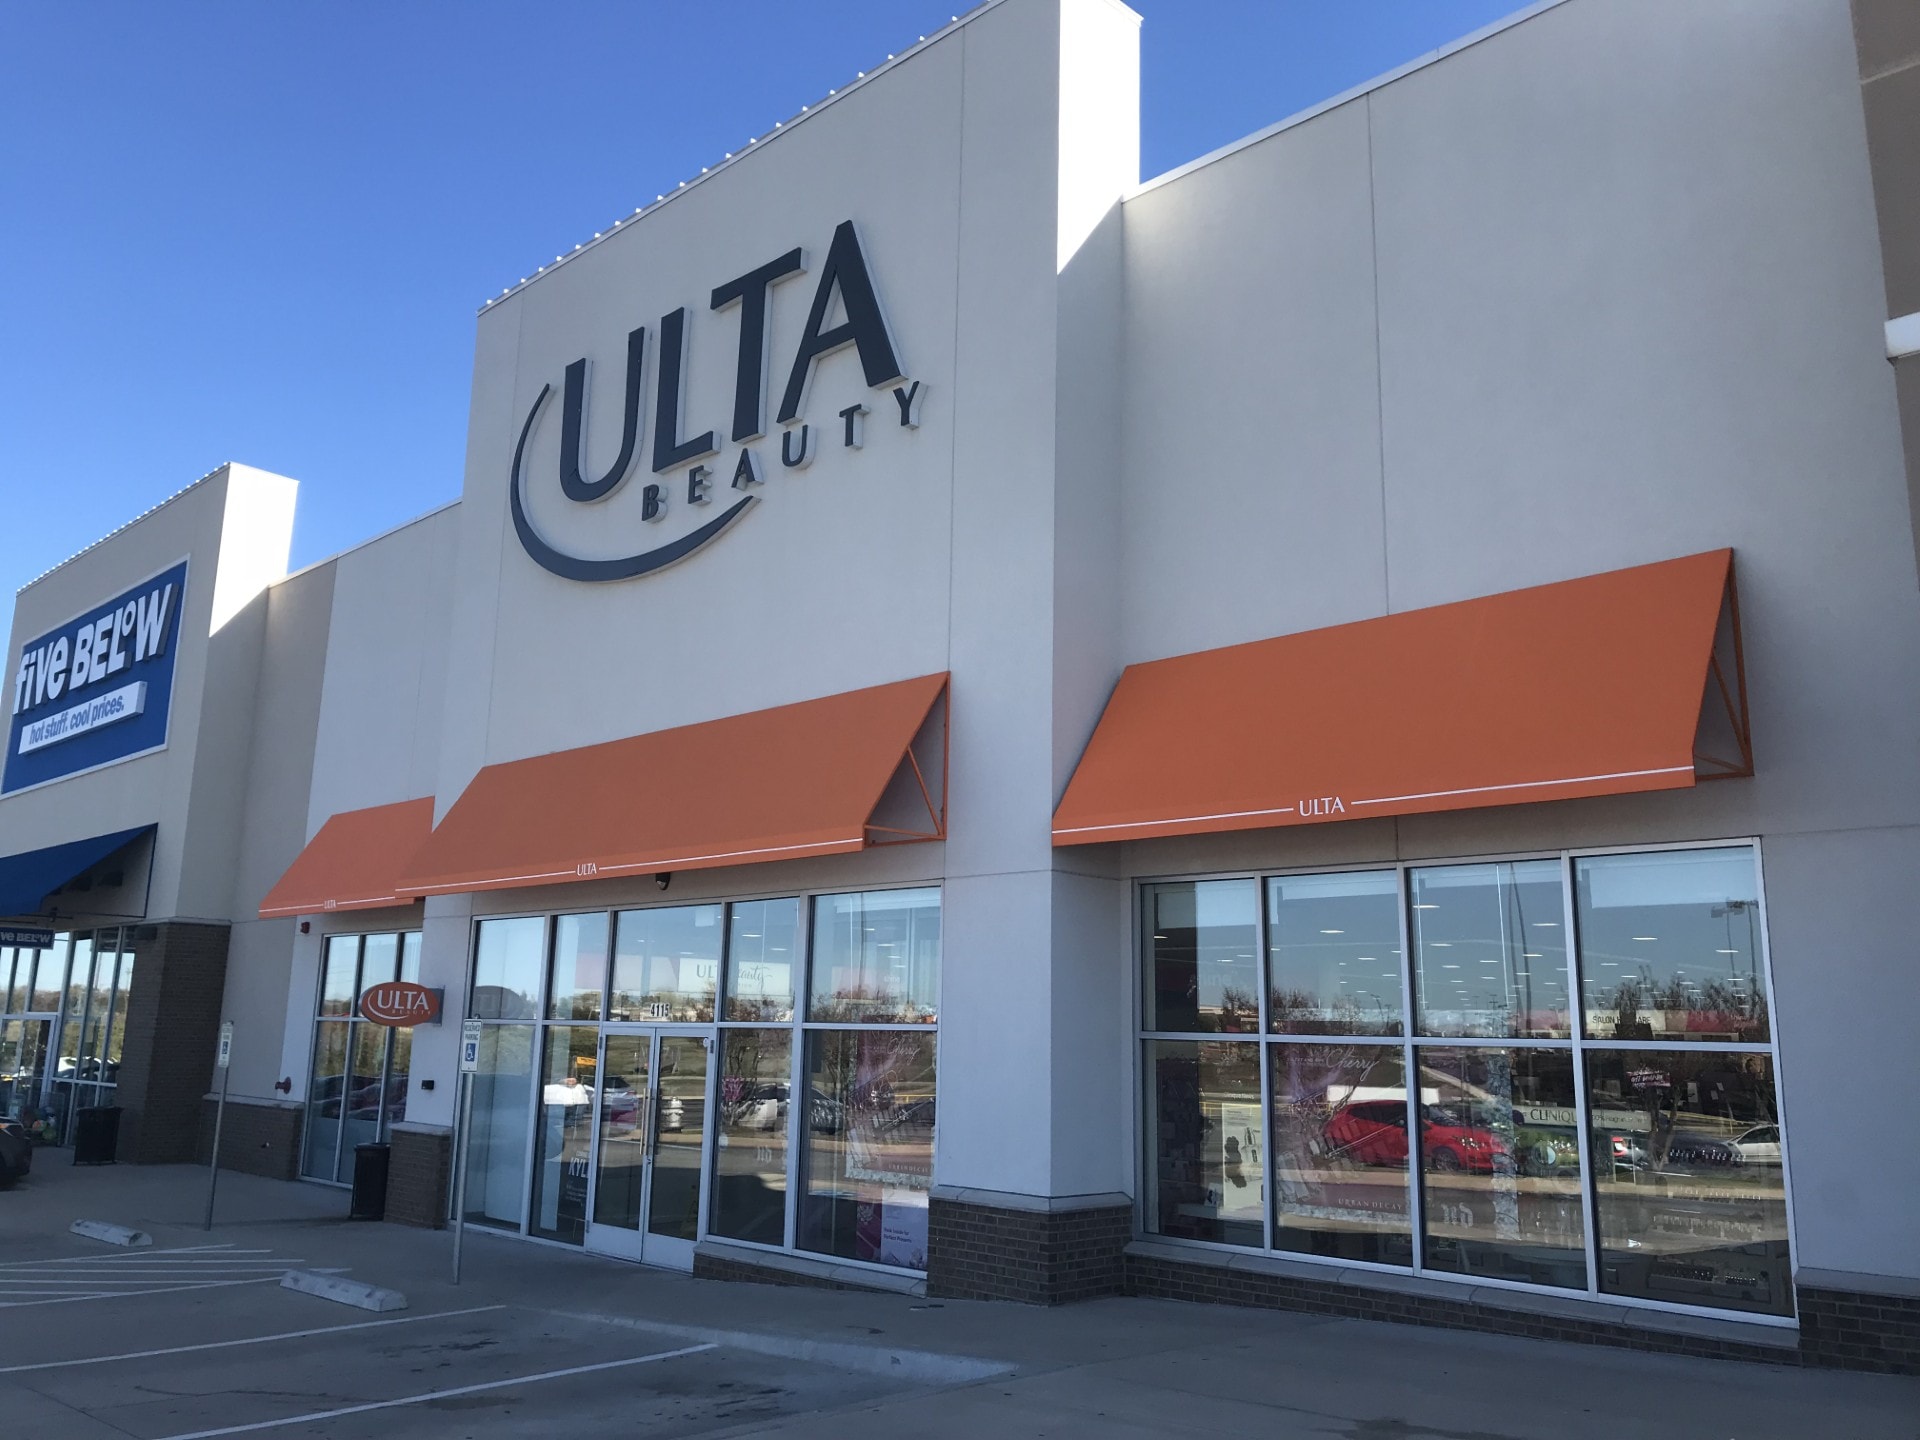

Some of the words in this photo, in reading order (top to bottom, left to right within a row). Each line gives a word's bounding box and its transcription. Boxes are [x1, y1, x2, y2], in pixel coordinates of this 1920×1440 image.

[560, 219, 907, 503] ULTA
[641, 380, 927, 523] BEAUTY
[29, 723, 44, 745] hot
[45, 711, 69, 738] stuff.
[70, 706, 91, 729] cool
[91, 695, 125, 723] prices.
[1299, 796, 1346, 817] ULTA
[576, 862, 597, 876] ULTA
[377, 989, 430, 1010] ULTA
[650, 1003, 670, 1017] 4115
[1592, 1015, 1616, 1025] SALON
[1326, 1045, 1380, 1082] Cherry
[1530, 1107, 1577, 1124] CLINIQU
[568, 1156, 590, 1178] KYL
[1338, 1197, 1369, 1208] URBAN
[1372, 1200, 1402, 1211] DECAY
